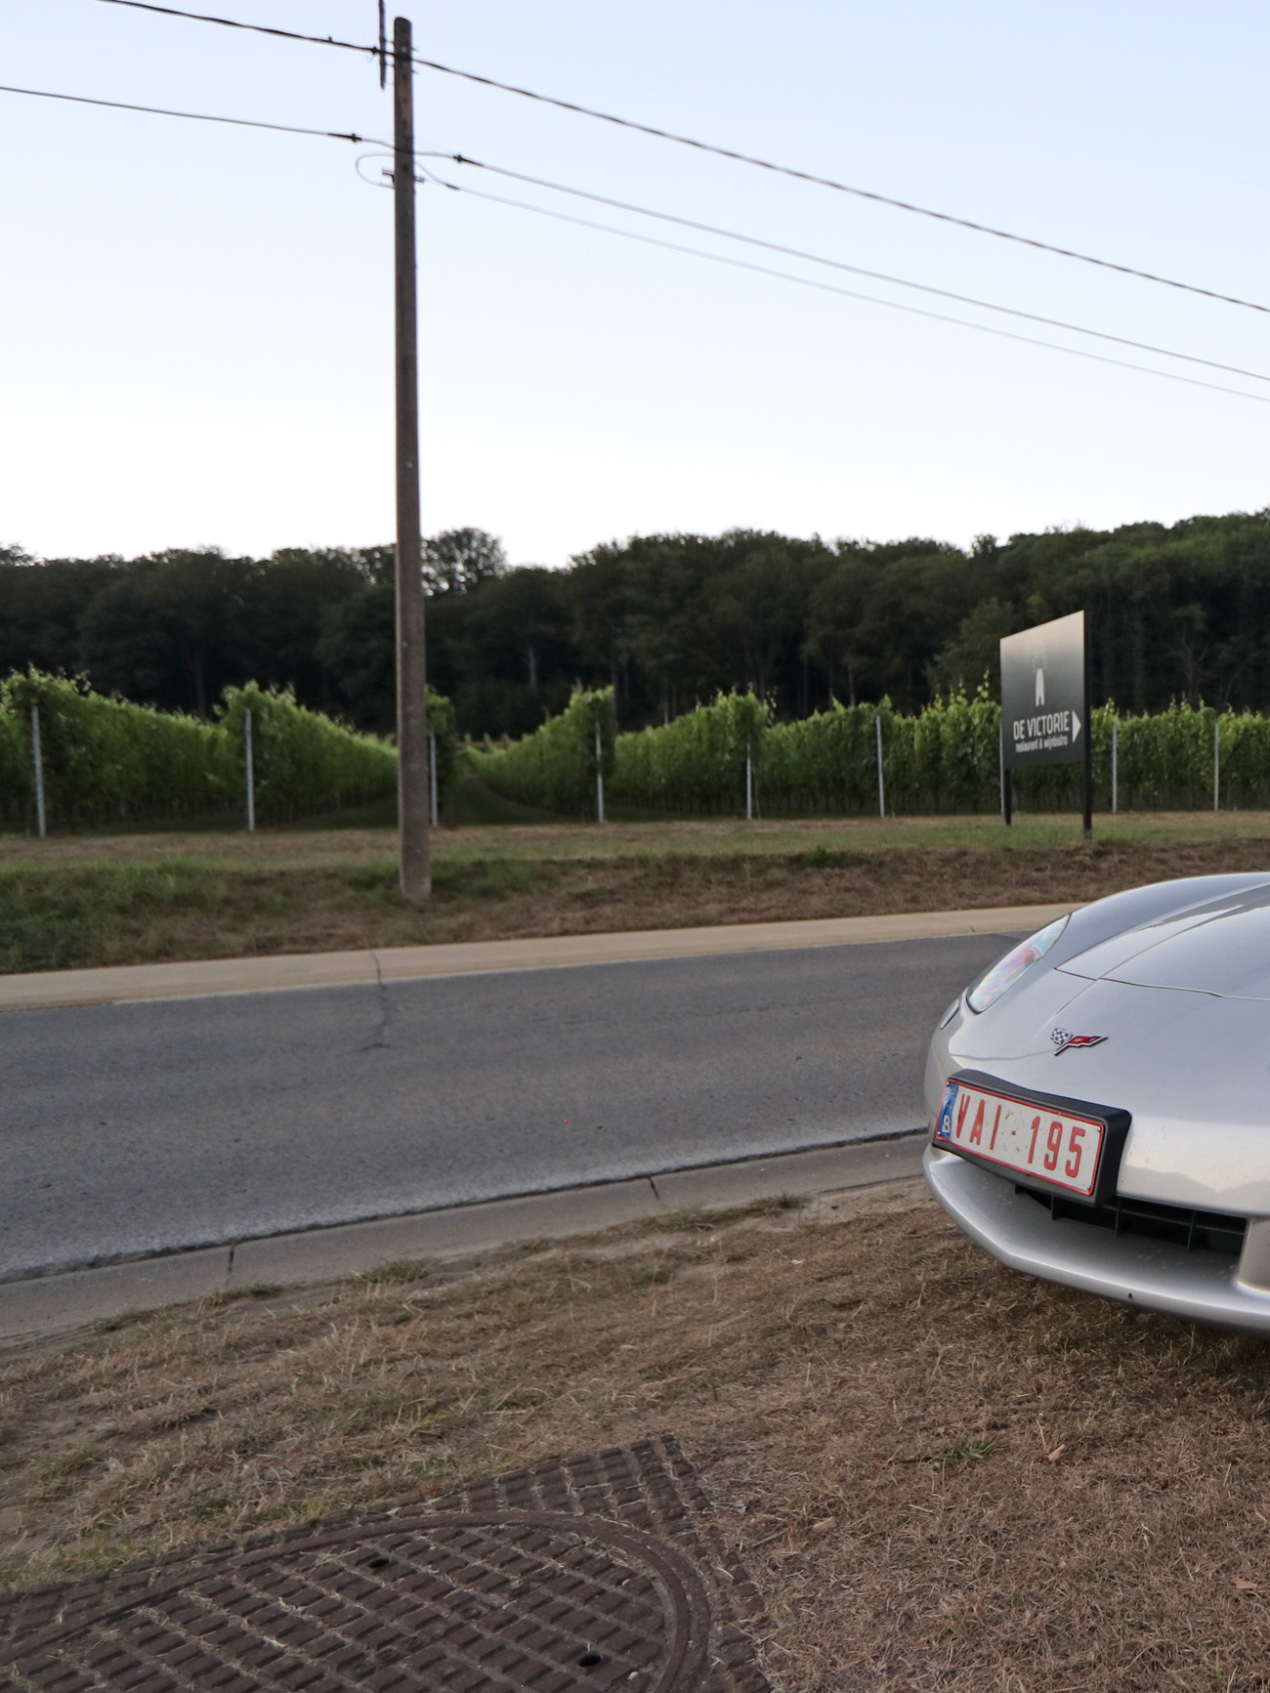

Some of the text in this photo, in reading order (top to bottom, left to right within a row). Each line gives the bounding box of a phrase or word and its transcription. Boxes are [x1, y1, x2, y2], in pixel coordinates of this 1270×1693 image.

[1013, 710, 1070, 741] DE VICTORIE
[941, 1114, 951, 1133] B
